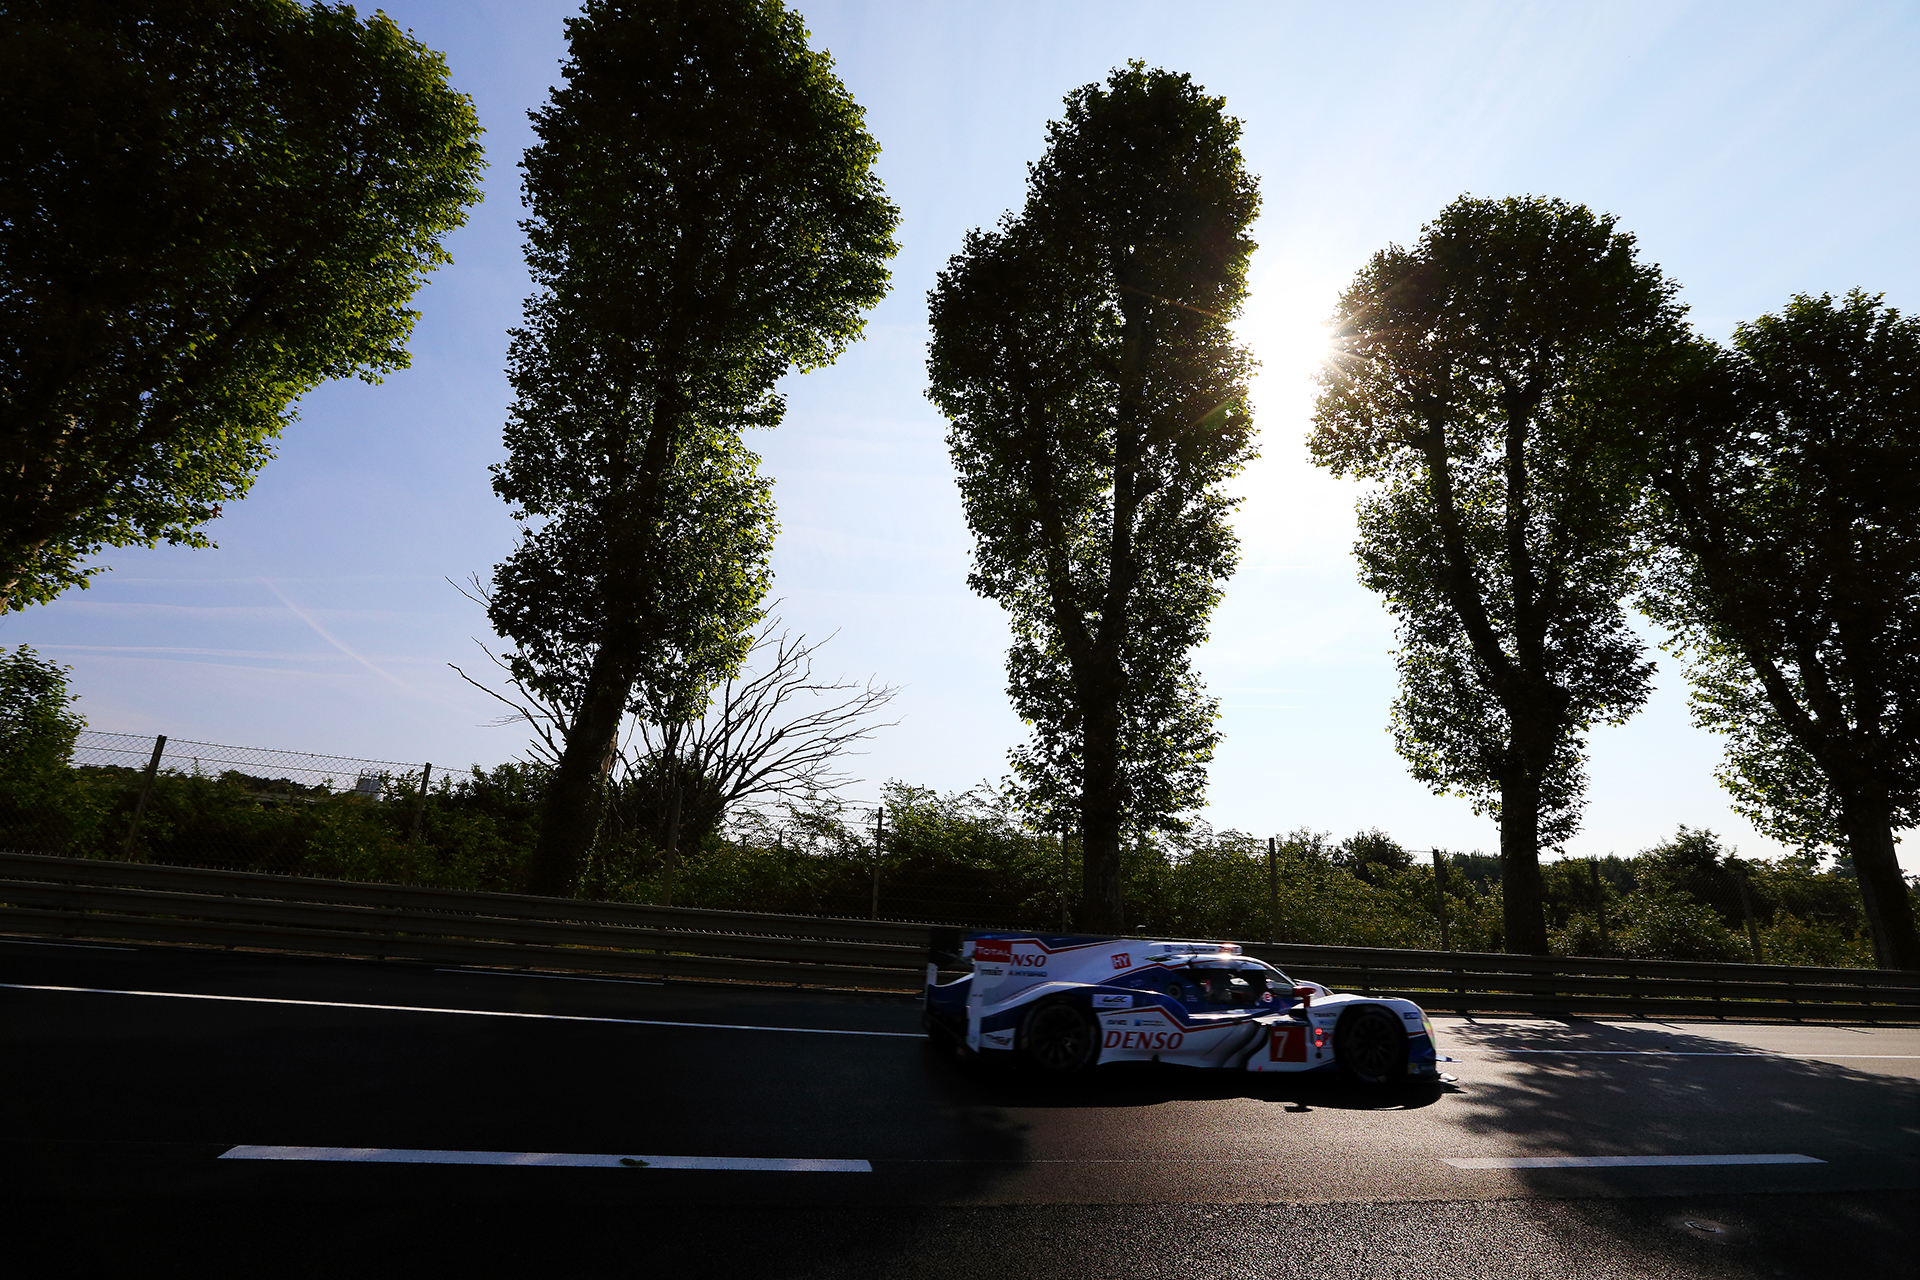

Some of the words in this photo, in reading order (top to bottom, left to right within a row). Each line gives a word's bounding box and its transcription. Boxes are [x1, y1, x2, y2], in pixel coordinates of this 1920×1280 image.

[977, 946, 1011, 957] TOTAL
[1011, 954, 1047, 968] NSO
[1113, 956, 1130, 968] HY
[1104, 1031, 1184, 1051] DENSO
[1273, 1031, 1290, 1058] 7
